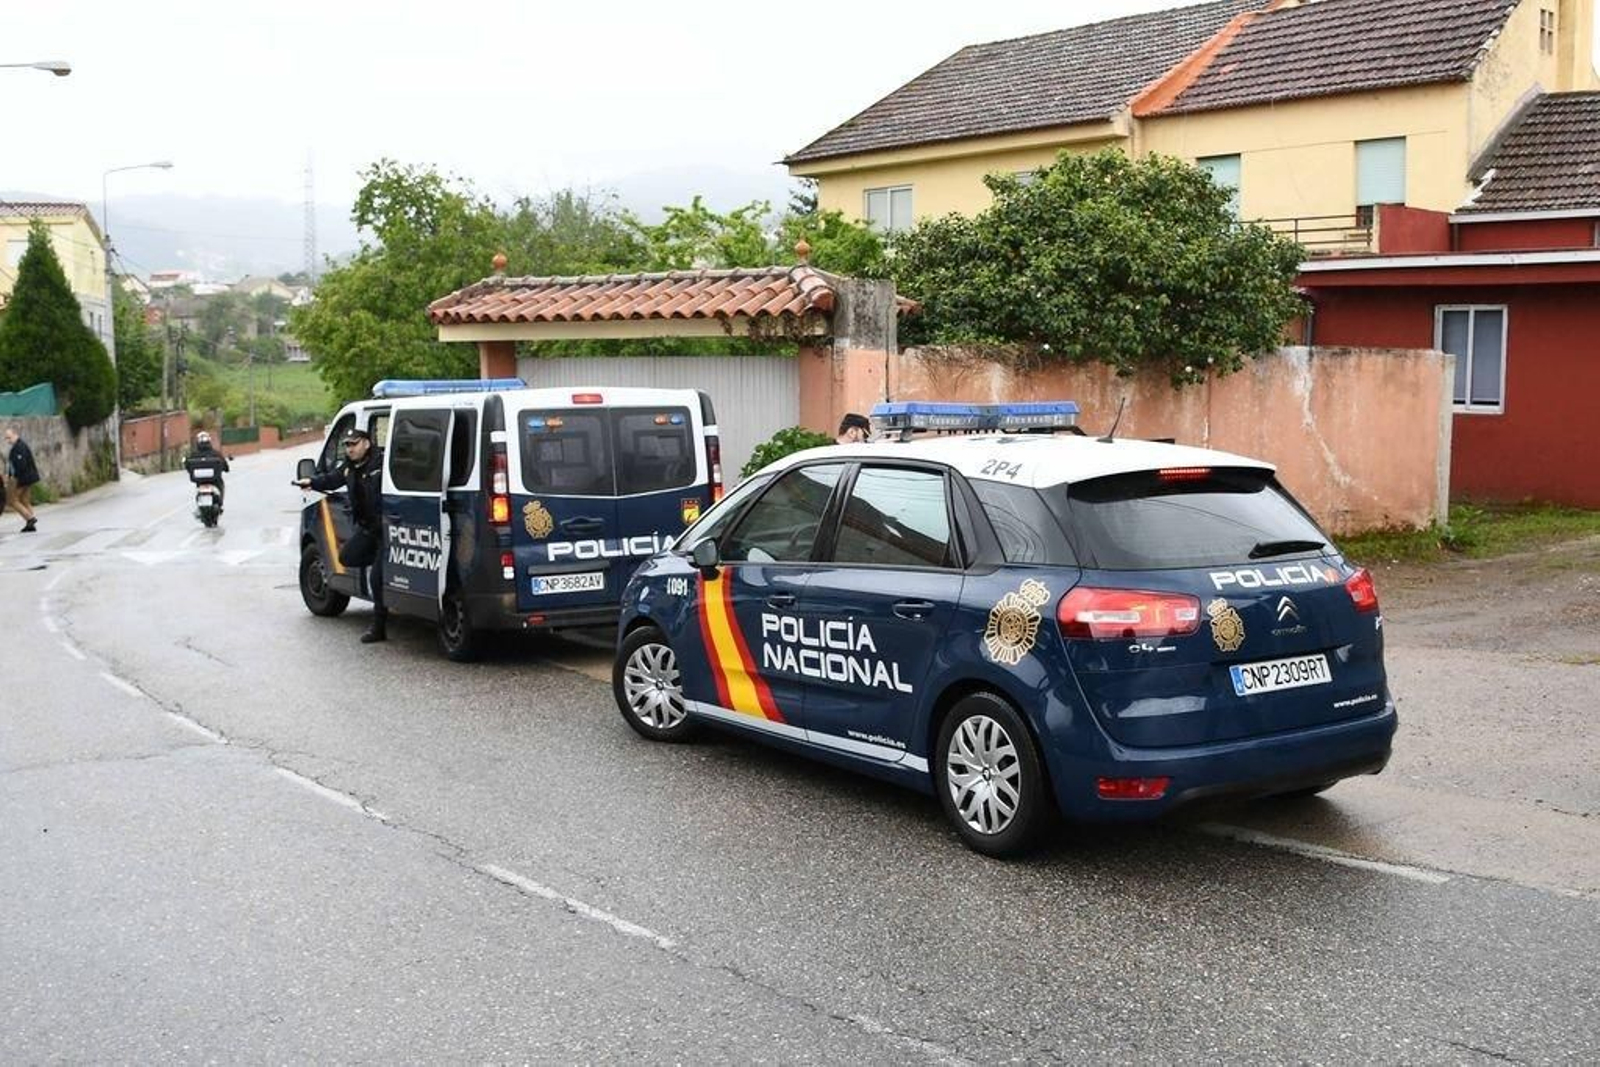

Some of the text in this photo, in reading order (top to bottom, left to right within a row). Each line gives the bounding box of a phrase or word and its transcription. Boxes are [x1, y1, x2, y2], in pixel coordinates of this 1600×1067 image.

[980, 458, 1023, 480] 2P4
[388, 525, 442, 550] POLICÍA
[388, 546, 442, 571] NACIONA
[1210, 561, 1326, 590] POLICÍA
[761, 612, 877, 653] POLICÍA
[763, 643, 913, 693] NACIONAL
